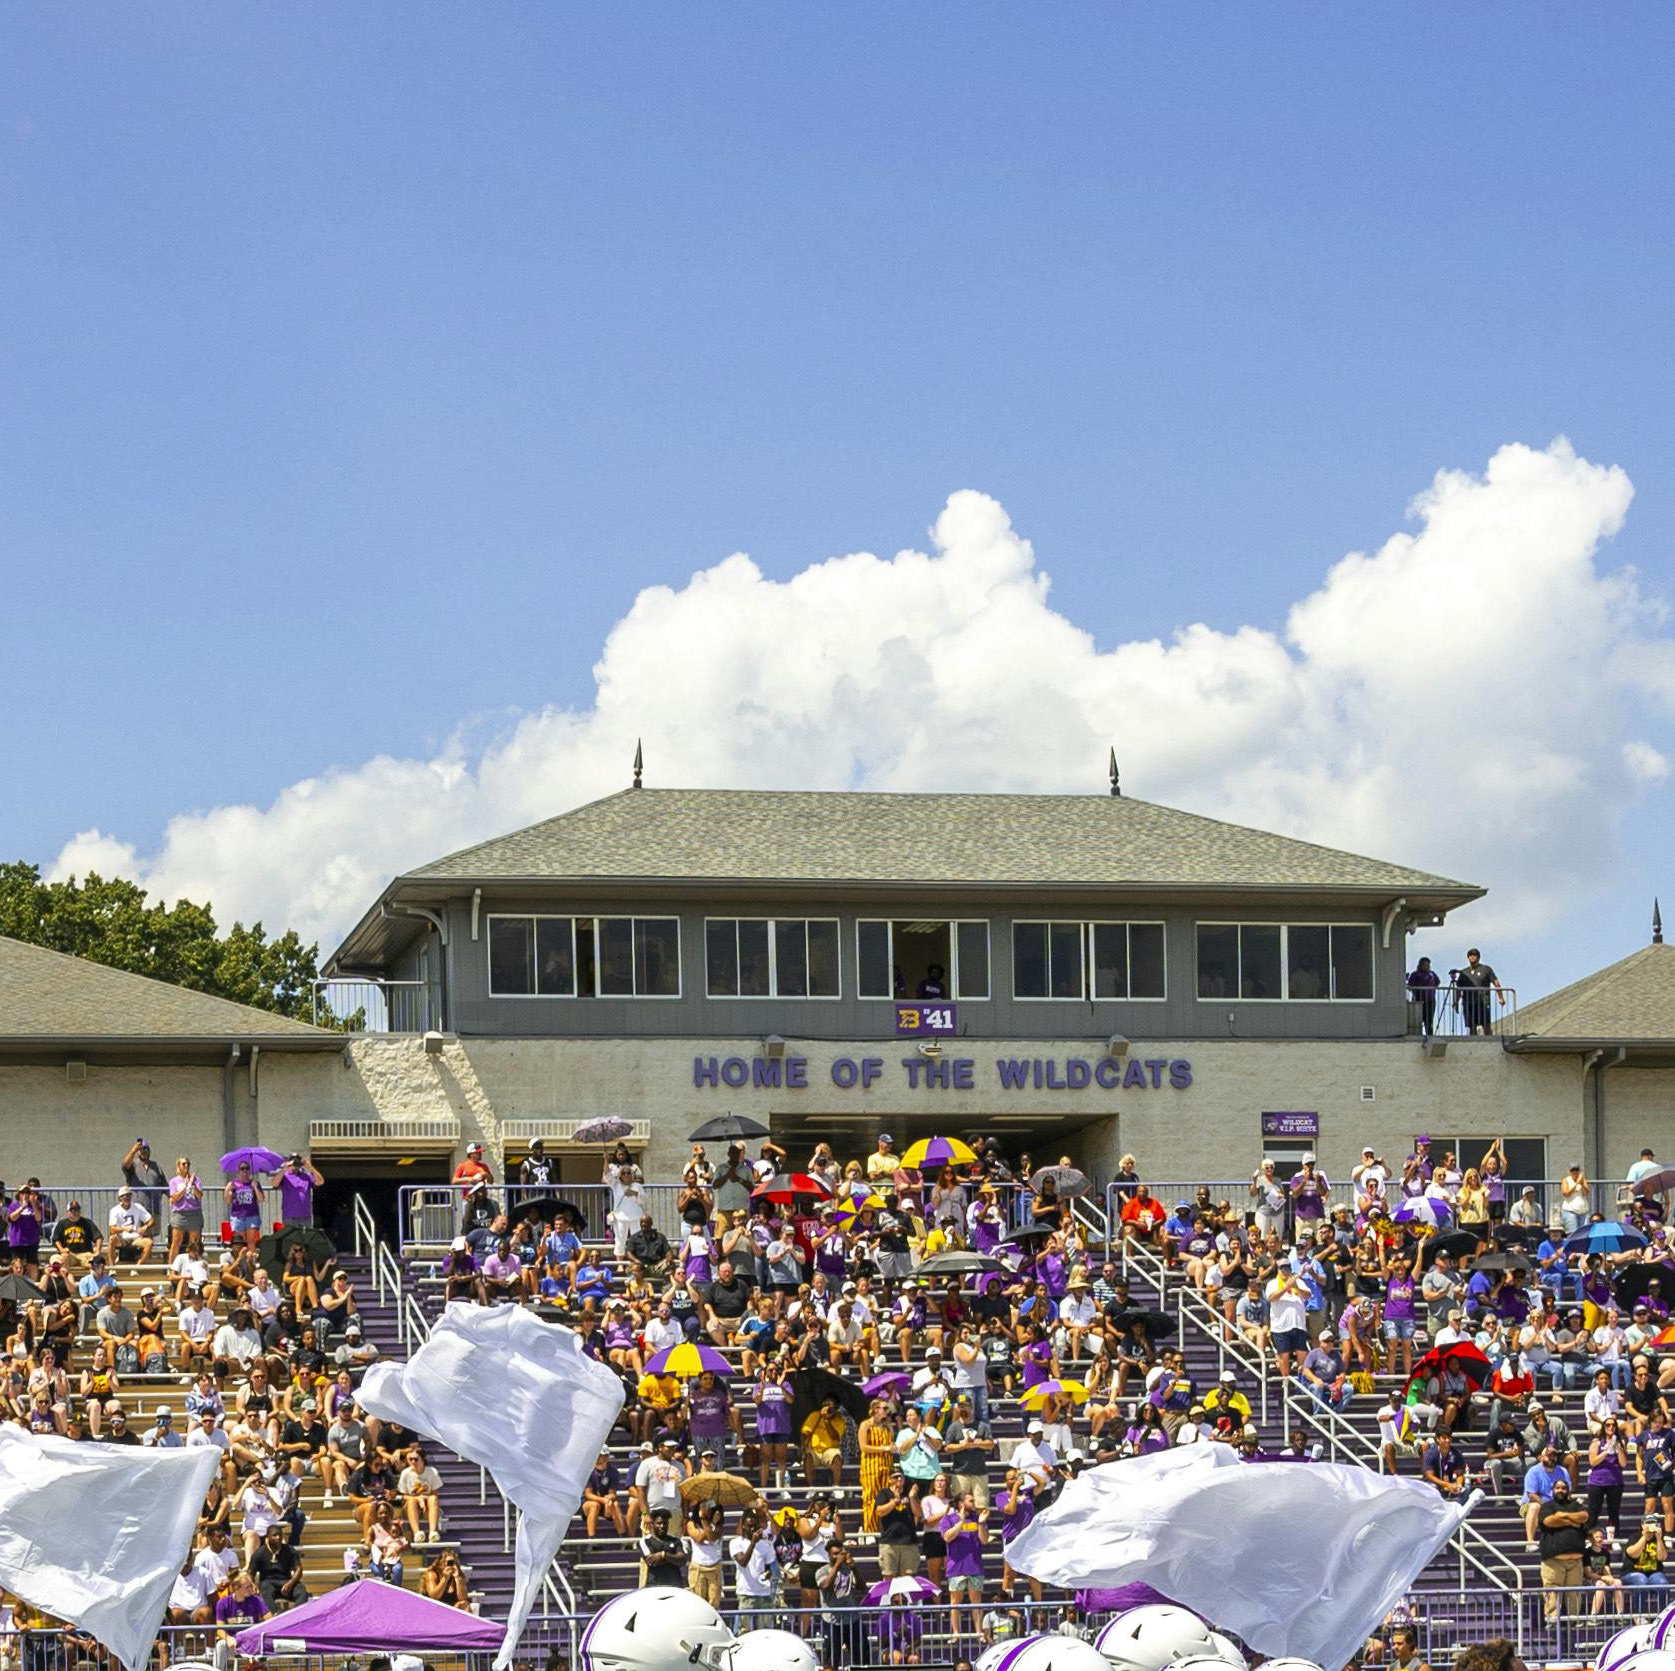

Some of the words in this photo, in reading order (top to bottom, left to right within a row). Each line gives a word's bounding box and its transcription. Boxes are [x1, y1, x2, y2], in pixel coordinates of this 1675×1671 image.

[693, 1057, 808, 1088] HOME
[831, 1058, 884, 1088] OF
[902, 1058, 975, 1089] THE
[997, 1059, 1193, 1089] WILDCATS
